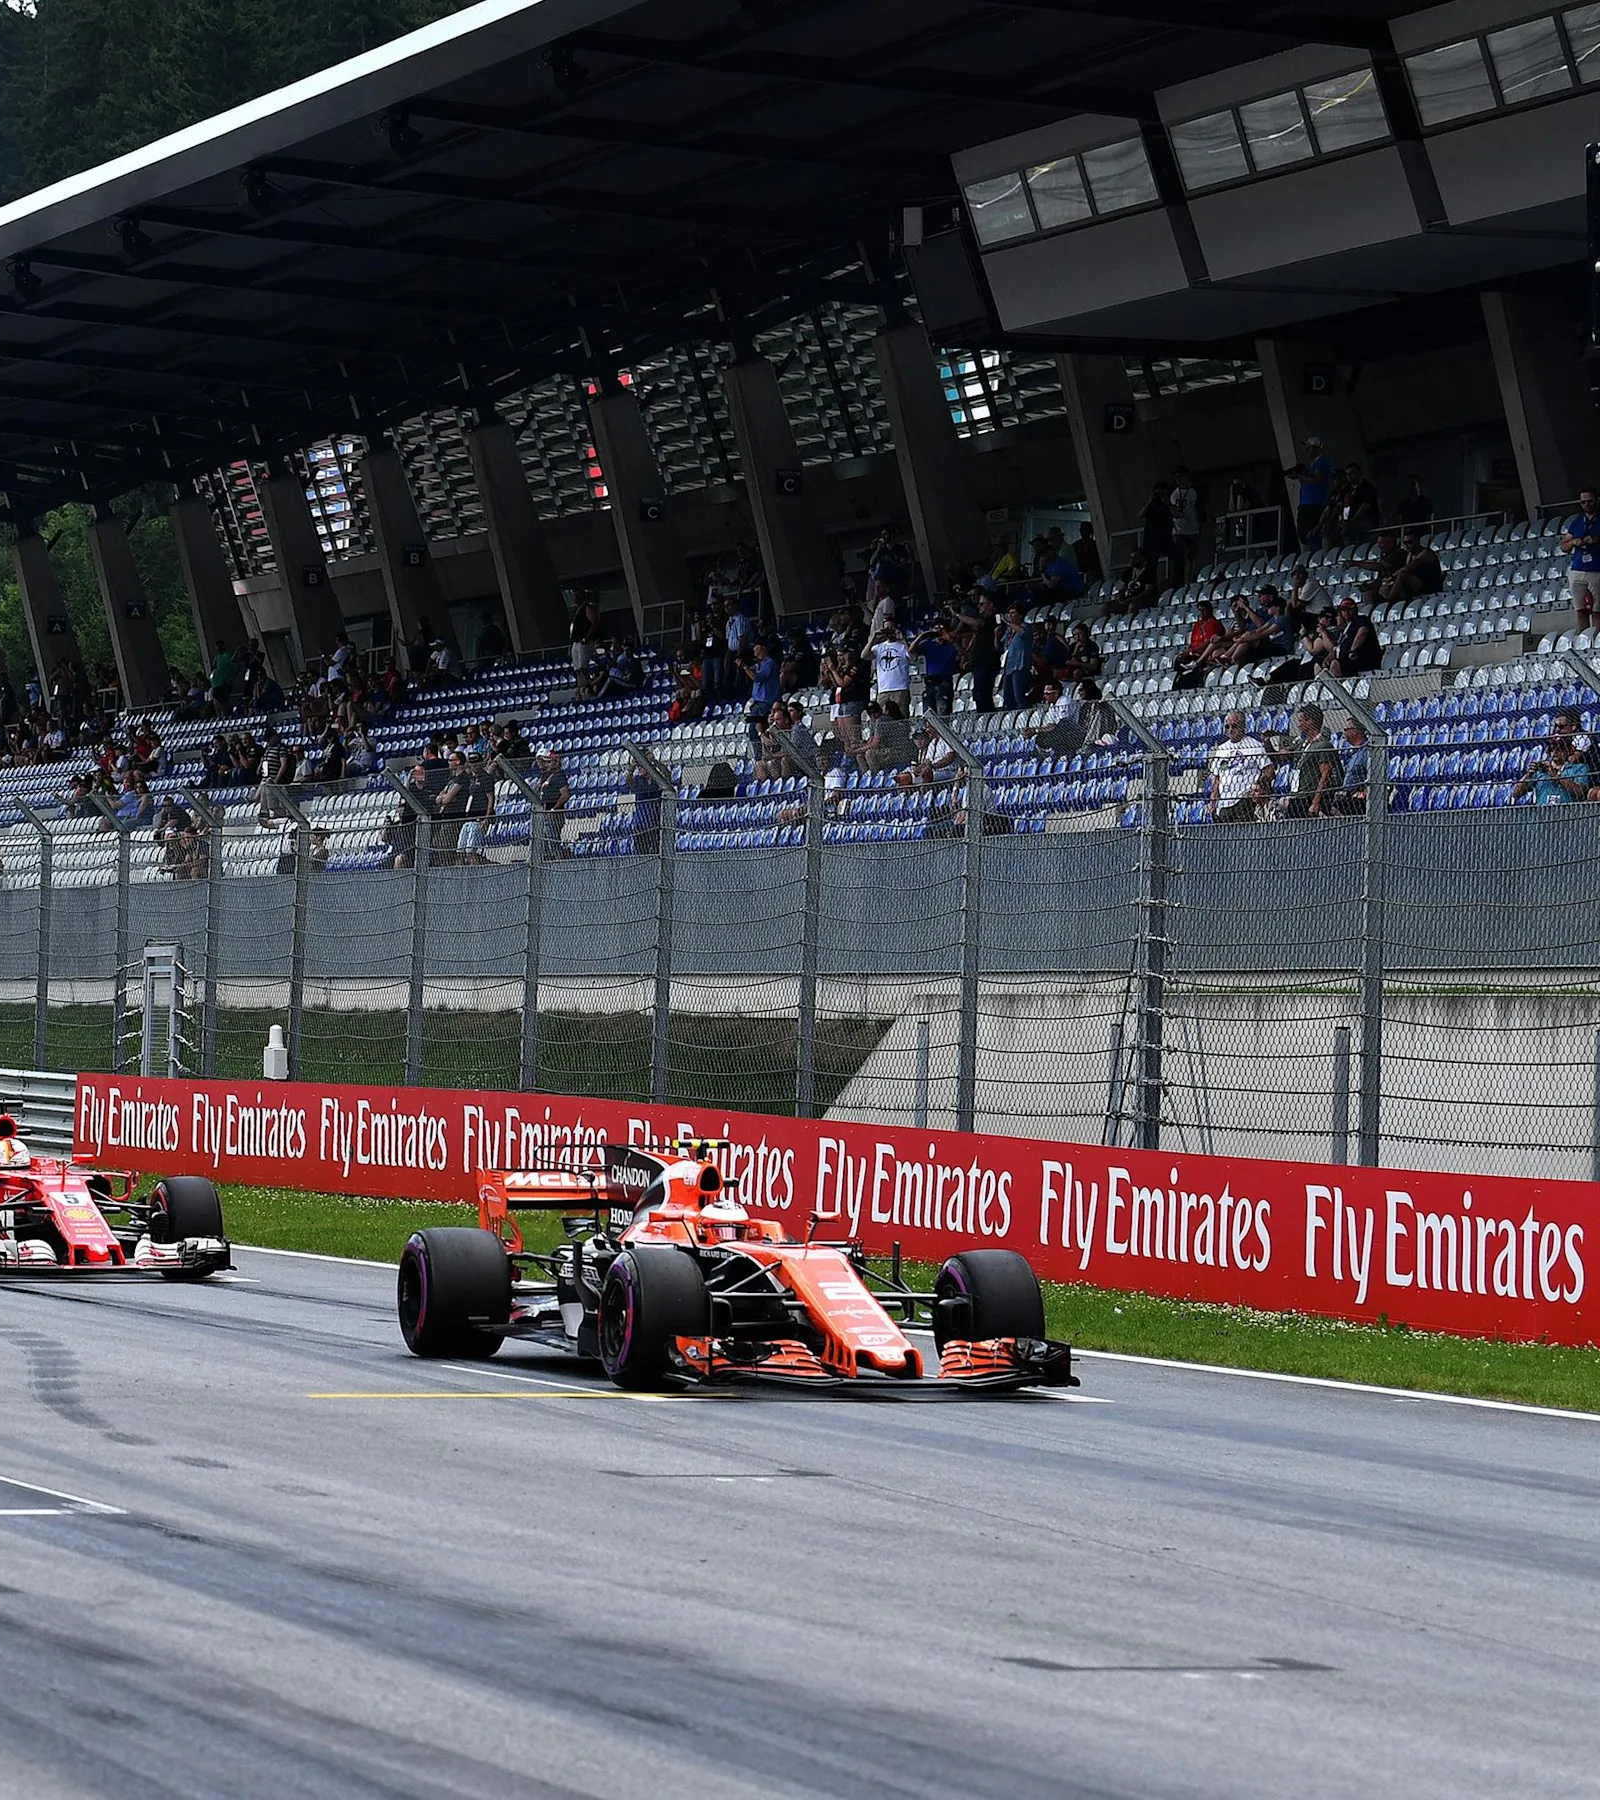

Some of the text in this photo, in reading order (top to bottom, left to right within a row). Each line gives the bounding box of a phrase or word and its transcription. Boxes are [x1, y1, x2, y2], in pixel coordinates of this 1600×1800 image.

[1312, 375, 1326, 391] D
[1113, 415, 1126, 430] D
[783, 478, 795, 492] C
[647, 506, 658, 519] C
[409, 553, 420, 565] B
[308, 573, 318, 585] B
[130, 606, 141, 617] A
[52, 622, 62, 633] A
[79, 1085, 180, 1157] Fly Emirates
[192, 1091, 307, 1169] Fly Emirates
[320, 1097, 448, 1179] Fly Emirates
[610, 1164, 651, 1189] CHANDON
[816, 1137, 1013, 1239] Fly Emirates
[63, 1193, 79, 1205] 5
[1039, 1160, 1271, 1273] Fly Emirates
[1305, 1184, 1586, 1305] Fly Emirates
